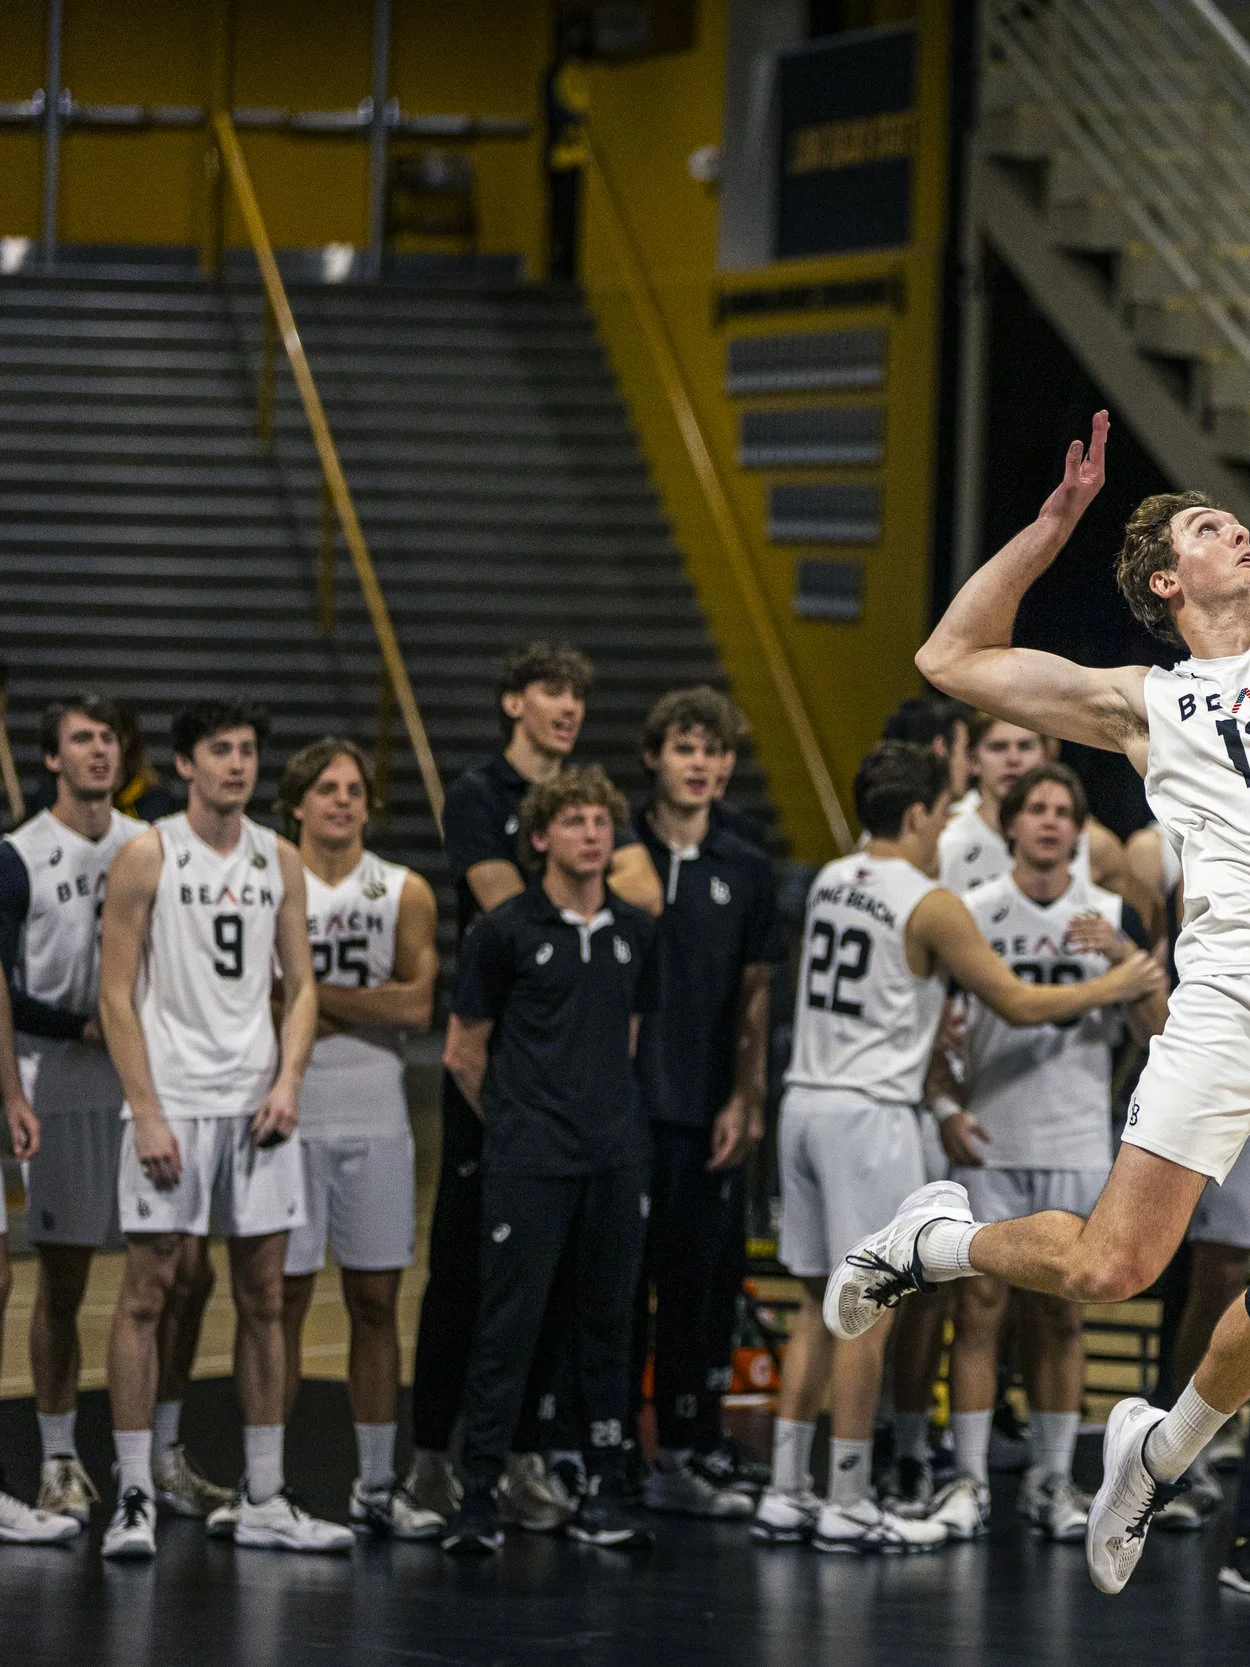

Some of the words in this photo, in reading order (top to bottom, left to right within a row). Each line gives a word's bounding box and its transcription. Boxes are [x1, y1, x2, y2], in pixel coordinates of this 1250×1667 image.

[180, 883, 274, 907] BEACH
[214, 914, 242, 978] 9
[810, 920, 871, 1018] 22
